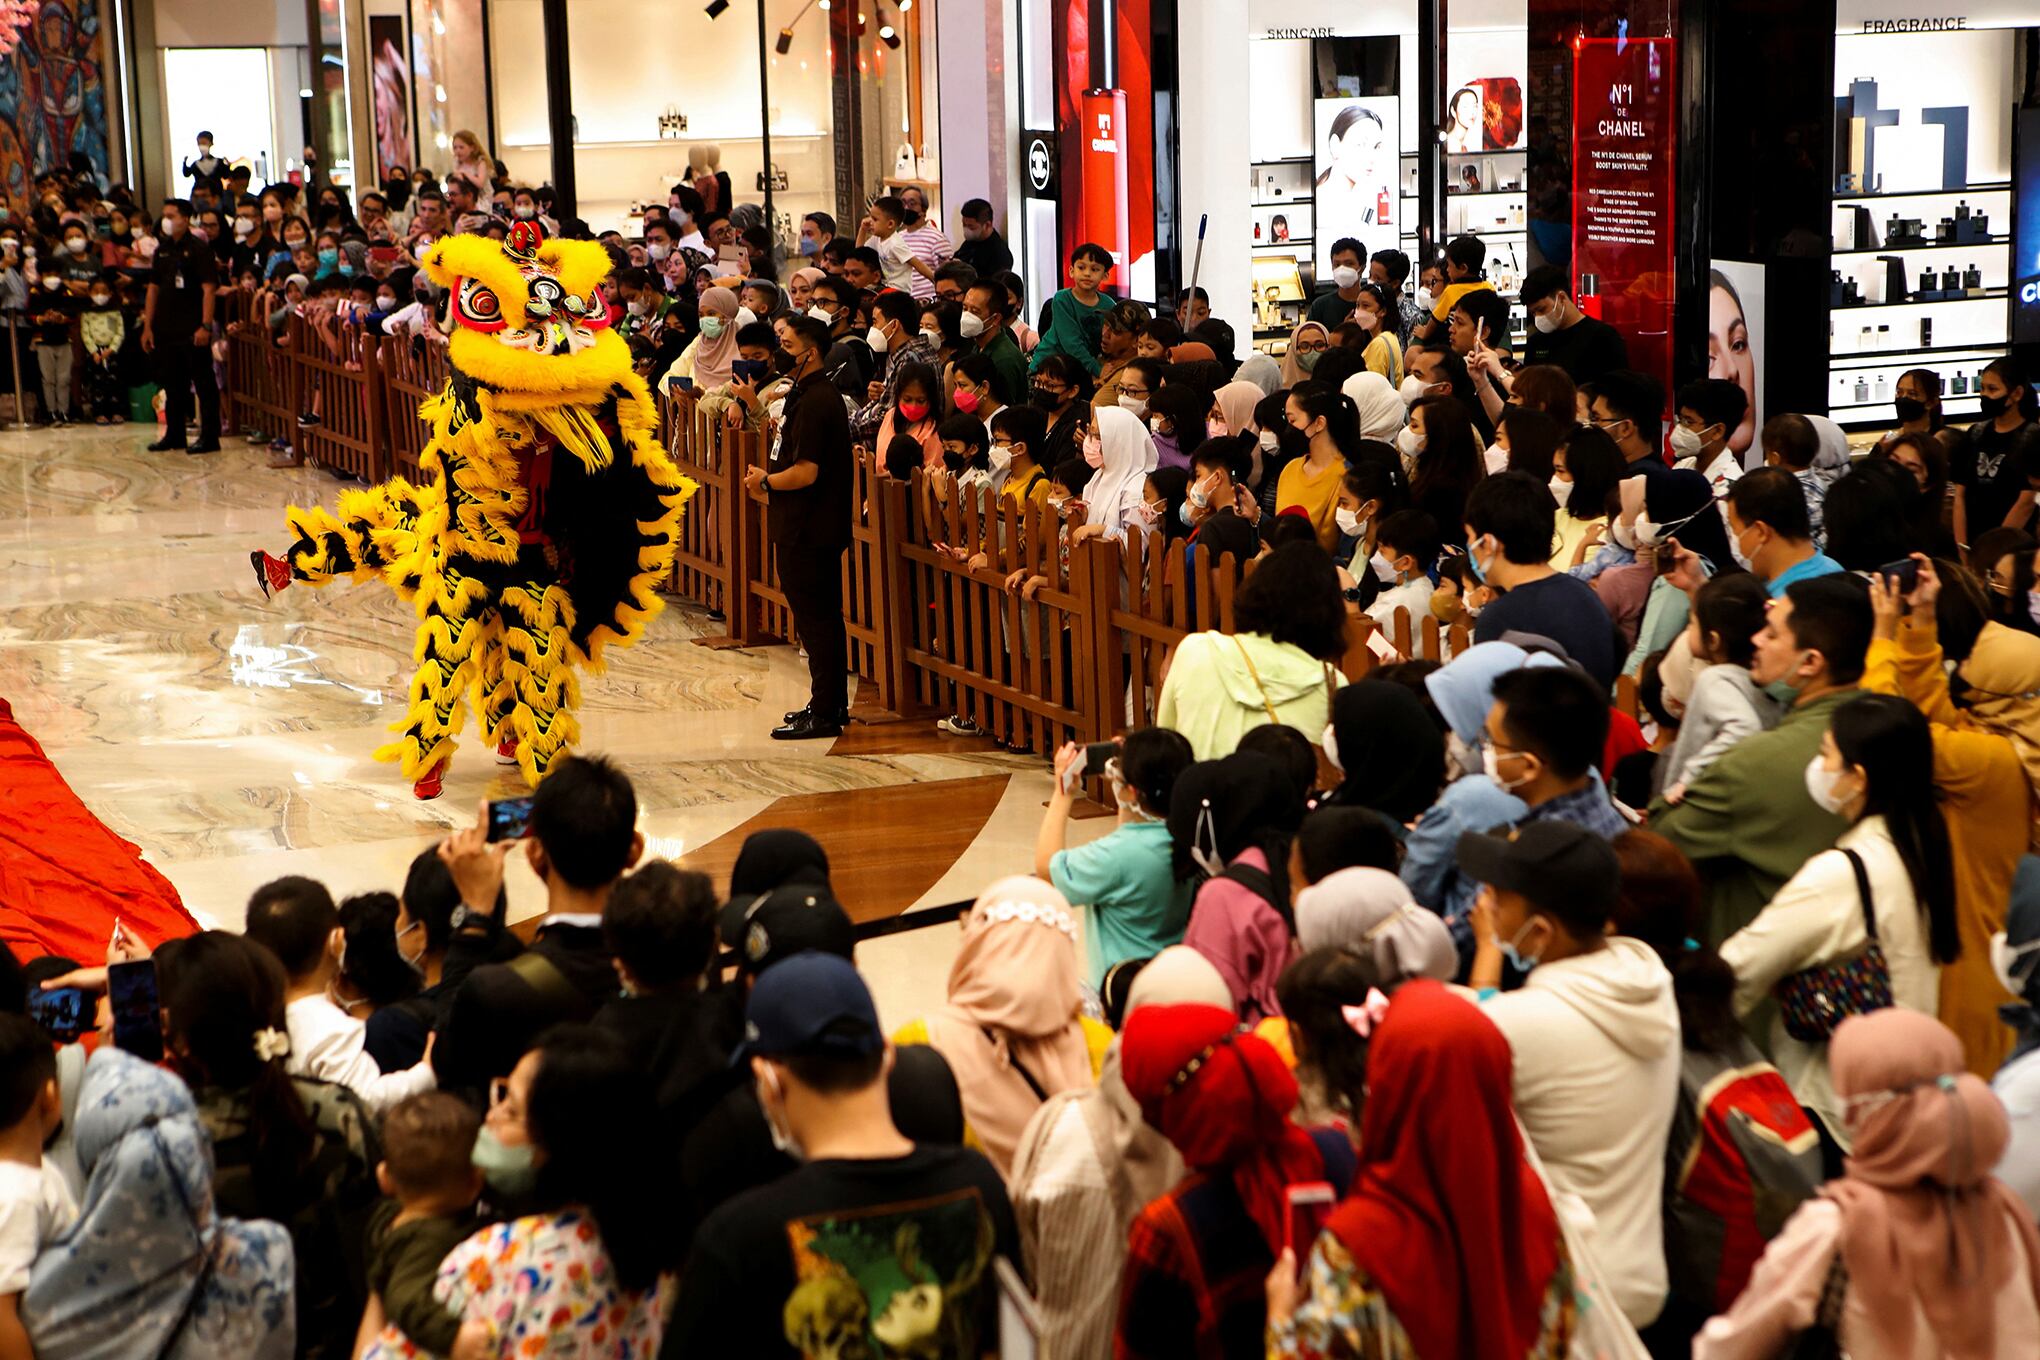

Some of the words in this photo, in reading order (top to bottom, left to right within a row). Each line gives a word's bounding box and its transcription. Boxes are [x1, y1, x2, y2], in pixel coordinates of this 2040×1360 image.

[1863, 17, 1967, 33] FRAGRANCE
[1267, 27, 1335, 39] SKINCARE
[1617, 108, 1626, 117] DE
[1598, 120, 1645, 137] CHANEL
[1591, 150, 1600, 158] THE
[1616, 152, 1634, 160] CHANEL
[1635, 153, 1652, 161] SERUM
[1596, 161, 1611, 169] BOOST
